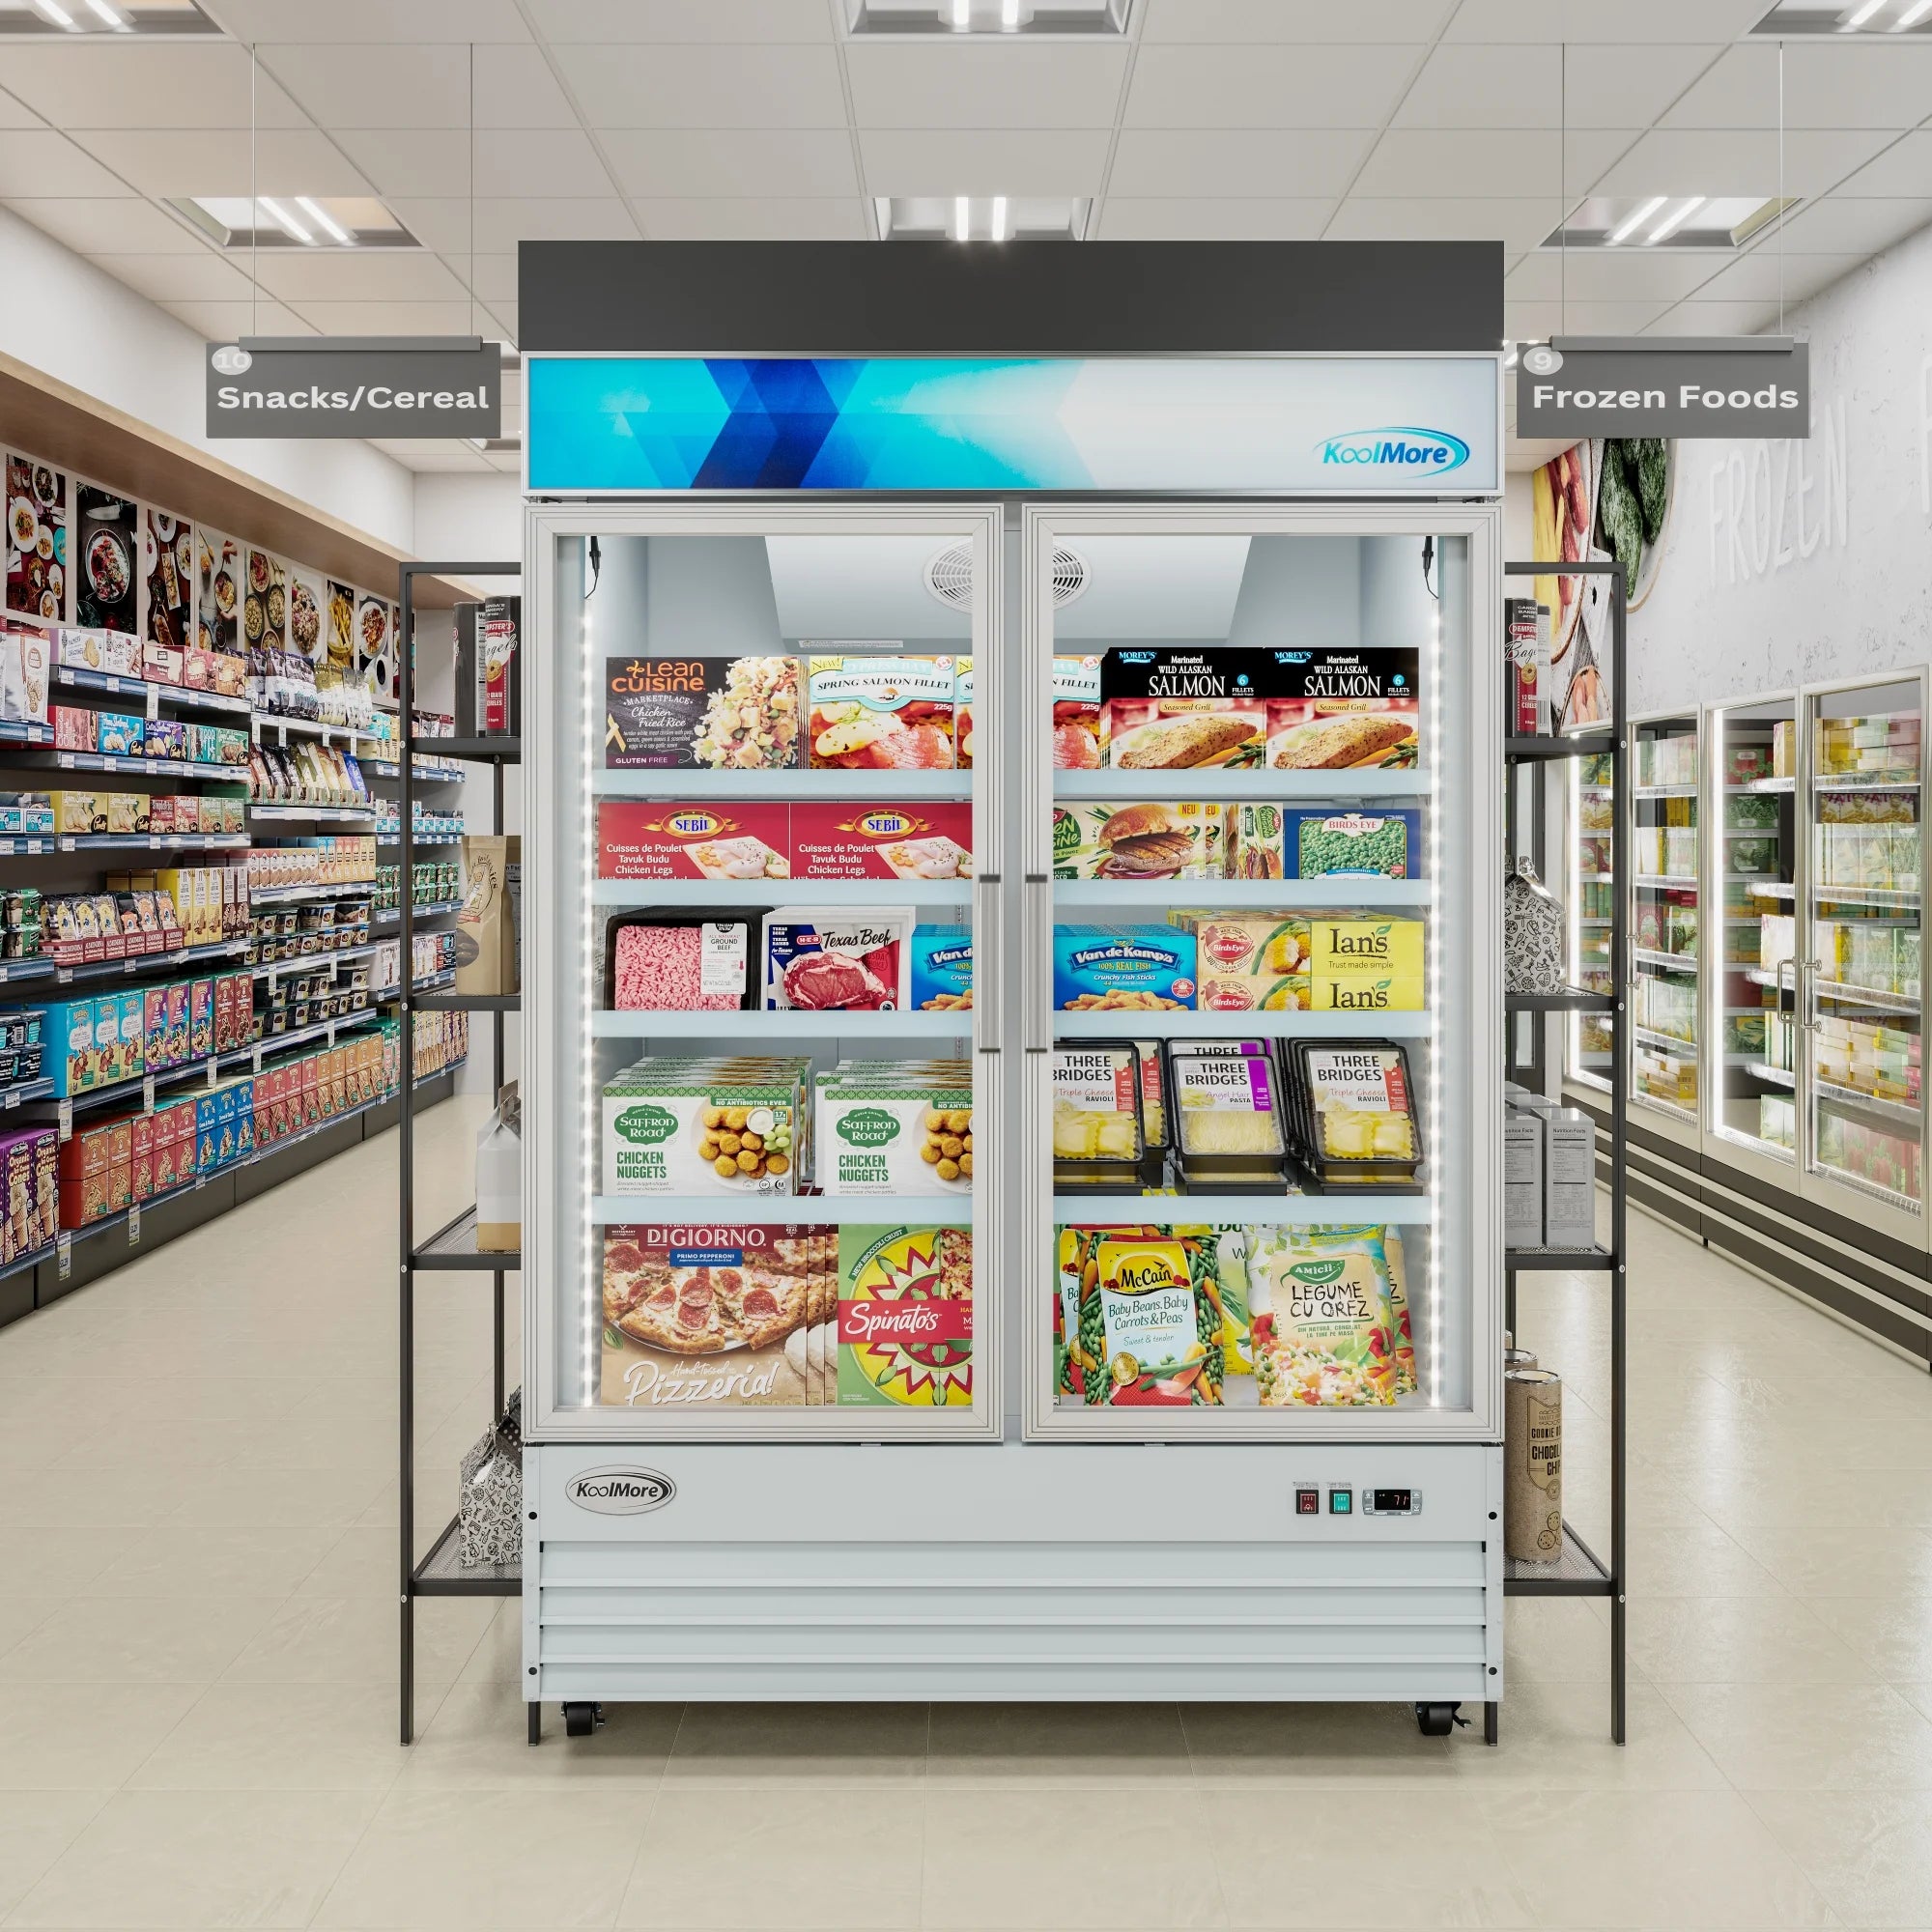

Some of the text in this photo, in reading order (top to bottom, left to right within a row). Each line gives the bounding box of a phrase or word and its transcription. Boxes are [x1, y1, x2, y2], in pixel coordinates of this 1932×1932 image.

[217, 353, 251, 369] 10
[1534, 353, 1551, 370] 9
[217, 385, 489, 412] Snacks/Cereal
[1533, 384, 1799, 409] Frozen Foods
[1322, 441, 1448, 464] KoolMore
[1171, 655, 1203, 664] Marinated
[1326, 655, 1359, 664] Marinated
[646, 662, 703, 676] Lean
[1158, 666, 1212, 674] WILD ALASKAN
[1314, 666, 1368, 674] WILD ALASKAN
[817, 677, 952, 691] SPRING SALMON FILLET
[1061, 679, 1098, 690] FILLET
[1149, 675, 1225, 696] SALMON
[1239, 676, 1246, 685] 6
[1304, 675, 1381, 696] SALMON
[1395, 676, 1402, 685] 6
[626, 696, 691, 705] MARKETPLACE
[631, 706, 673, 718] Chicken
[639, 717, 686, 727] Fried Rice
[1181, 804, 1196, 814] NEU
[1206, 805, 1216, 815] EU
[1328, 820, 1378, 829] BIRDS EYE
[607, 844, 682, 853] Cuisses de Poulet
[799, 844, 875, 853] Cuisses de Poulet
[619, 855, 669, 864] Tavuk Budu
[811, 855, 862, 864] Tavuk Budu
[615, 866, 673, 876] Chicken Legs
[808, 866, 866, 876] Chicken Legs
[822, 928, 892, 950] Texas Beef
[1329, 928, 1388, 953] Ian's
[932, 951, 959, 964] Van
[1075, 948, 1175, 964] Van de Kamp's
[1116, 962, 1134, 971] REAL
[1370, 961, 1394, 970] simple
[1329, 983, 1388, 1008] Ian's
[1065, 1056, 1111, 1066] THREE
[1332, 1056, 1379, 1066] THREE
[1200, 1064, 1246, 1073] THREE
[1185, 1075, 1247, 1085] BRIDGES
[1318, 1069, 1382, 1081] BRIDGES
[1059, 1089, 1082, 1098] Triple
[1329, 1088, 1352, 1097] Triple
[619, 1117, 674, 1128] Saffron
[841, 1120, 896, 1131] Saffron
[630, 1128, 666, 1137] Road
[852, 1130, 888, 1140] Road
[36, 1145, 56, 1158] Organic
[617, 1151, 664, 1164] CHICKEN
[9, 1153, 30, 1168] Organic
[838, 1154, 885, 1167] CHICKEN
[36, 1162, 56, 1178] Cones
[617, 1166, 667, 1179] NUGGETS
[838, 1169, 889, 1181] NUGGETS
[9, 1172, 30, 1187] Cones
[647, 1229, 766, 1246] DIGIORNO
[852, 1229, 903, 1277] NEW BROCCOLI CRUST
[1121, 1266, 1172, 1289] McCain
[1292, 1282, 1363, 1300] LEGUME
[1109, 1295, 1188, 1318] Baby Beans, Baby
[1291, 1300, 1370, 1318] CU OREZ
[845, 1302, 939, 1341] Spinato's
[1115, 1313, 1183, 1330] Carrots & Peas
[1123, 1333, 1174, 1347] Sweet & tender
[624, 1360, 781, 1406] Pizzeria!
[1531, 1428, 1554, 1438] COOKIE
[1531, 1445, 1561, 1460] CHOCOL
[576, 1482, 659, 1496] KoolMore
